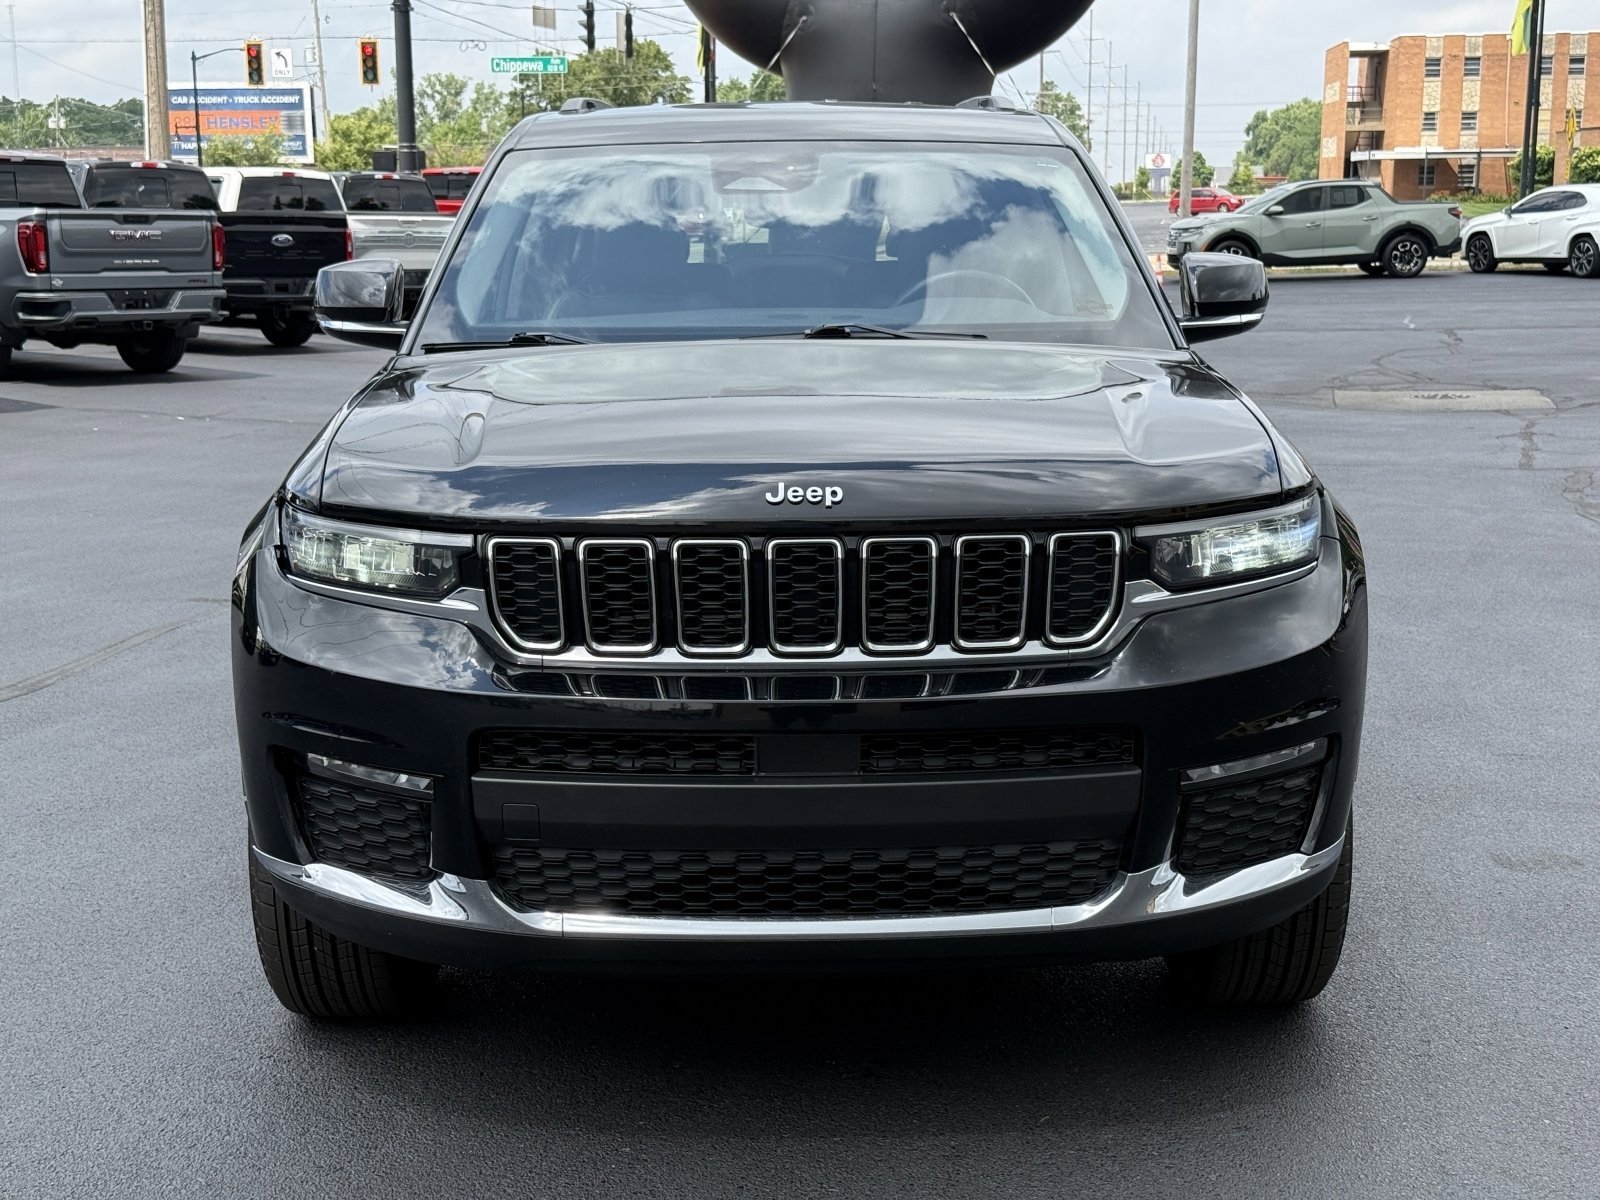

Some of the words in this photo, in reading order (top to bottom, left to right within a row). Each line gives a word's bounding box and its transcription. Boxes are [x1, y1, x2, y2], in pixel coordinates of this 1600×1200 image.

[493, 58, 544, 72] Chippewa
[171, 95, 188, 104] CAR
[233, 95, 260, 104] TRUCK
[261, 95, 300, 104] ACCIDENT
[765, 482, 844, 508] Jeep
